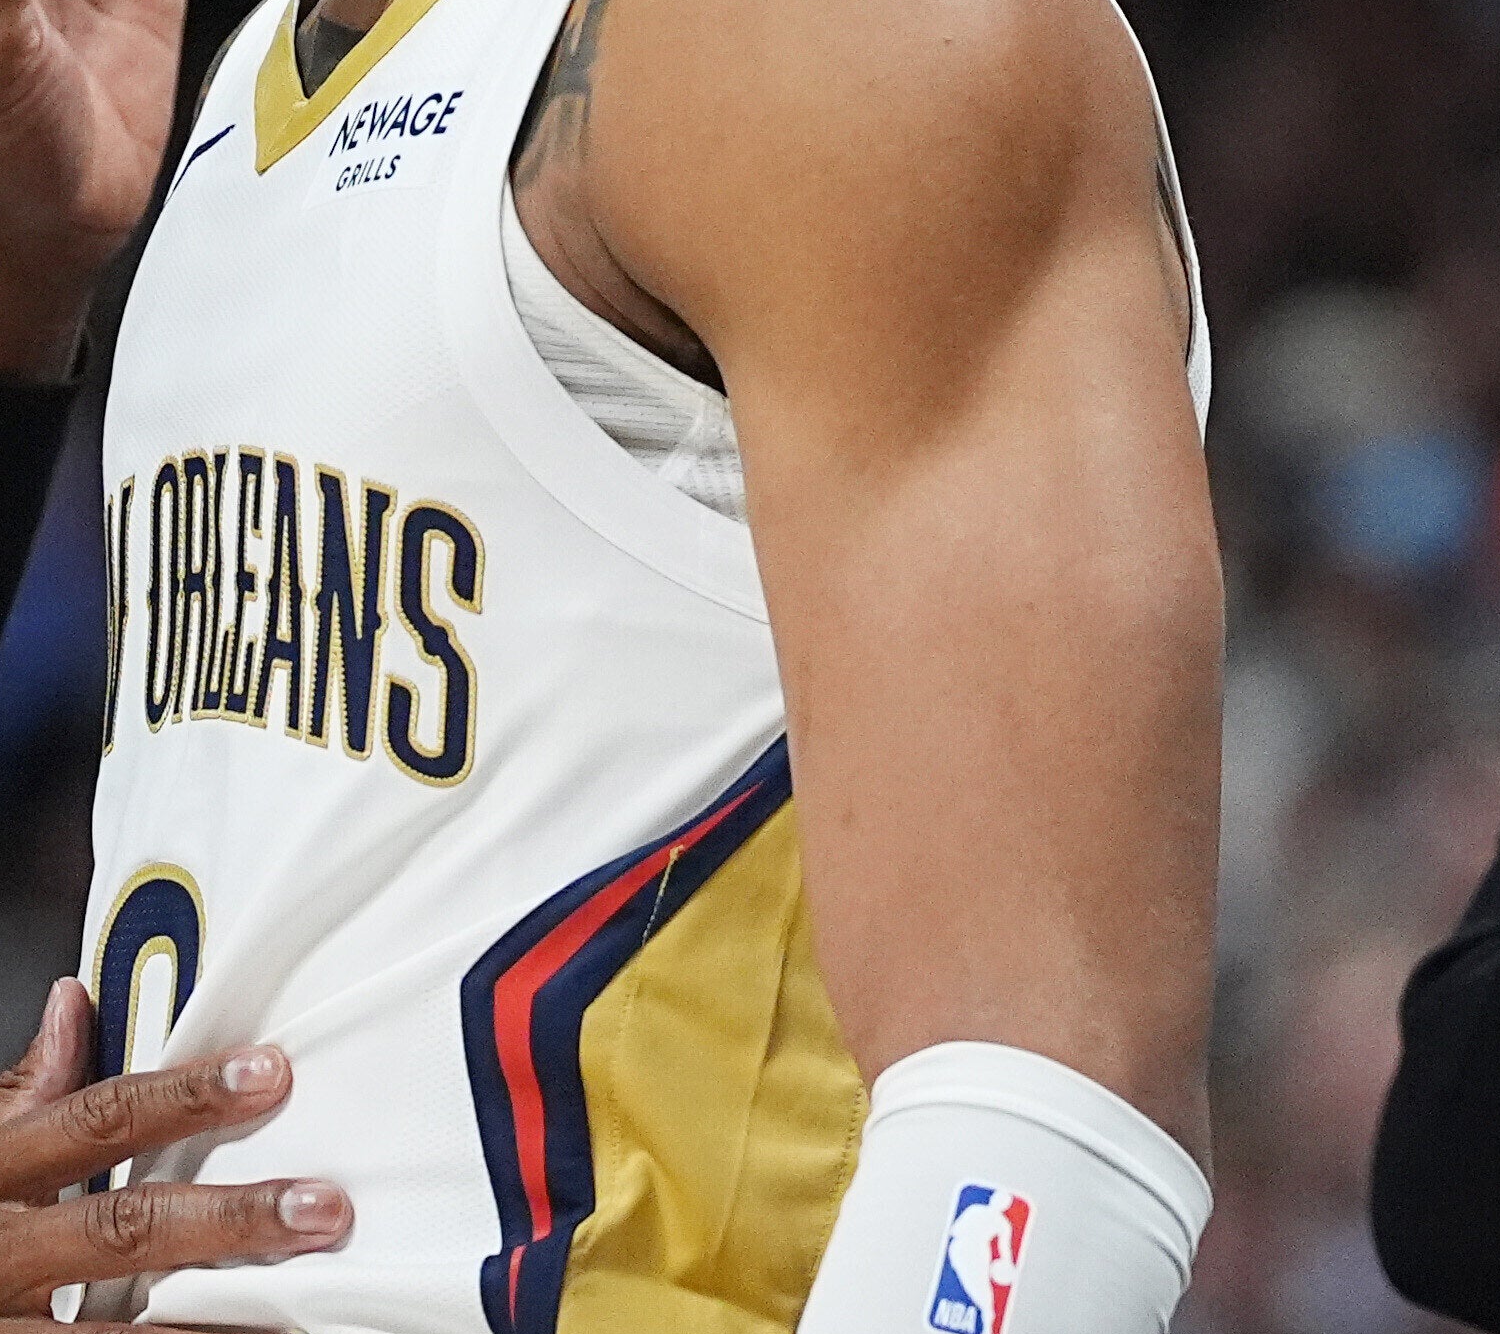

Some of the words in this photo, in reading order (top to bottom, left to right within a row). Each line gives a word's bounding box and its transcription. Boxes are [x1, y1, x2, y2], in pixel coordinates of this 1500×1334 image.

[328, 90, 464, 157] NEWAGE
[336, 154, 402, 193] GRILLS
[145, 443, 486, 788] ORLEANS
